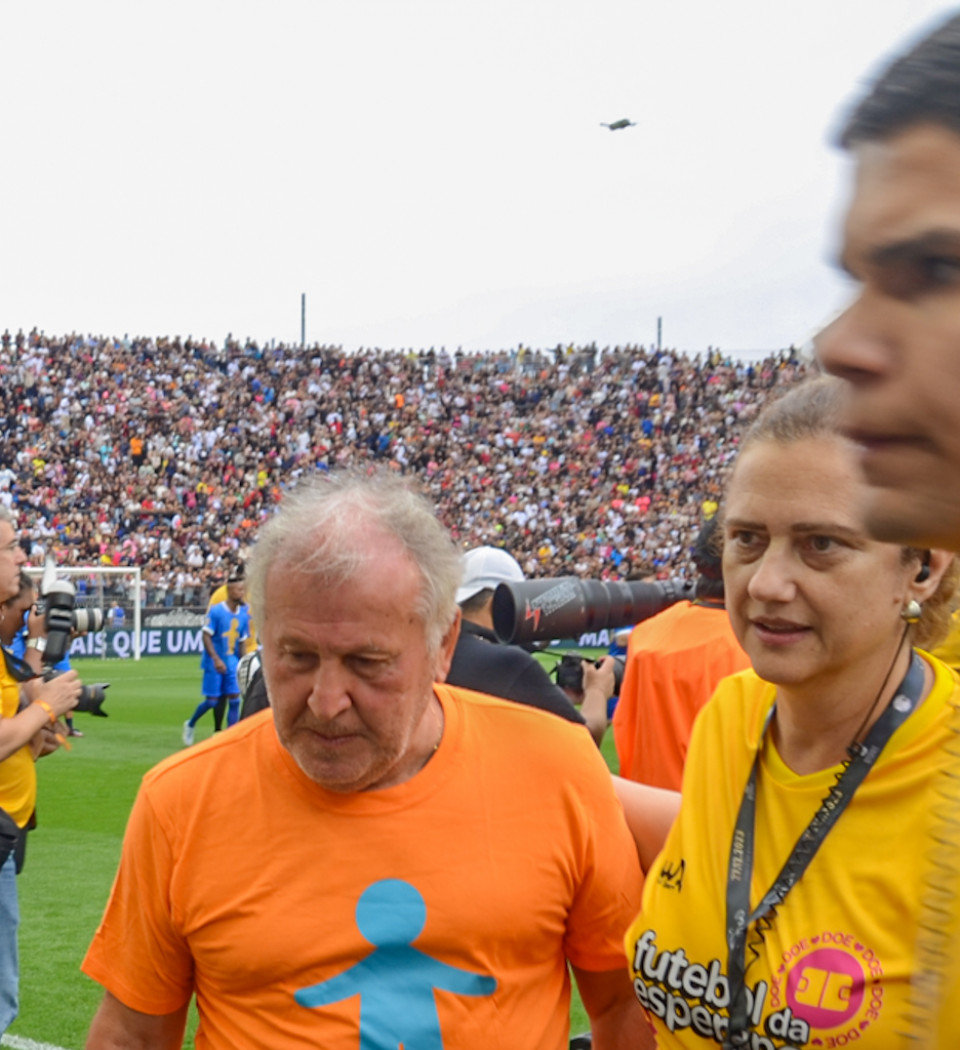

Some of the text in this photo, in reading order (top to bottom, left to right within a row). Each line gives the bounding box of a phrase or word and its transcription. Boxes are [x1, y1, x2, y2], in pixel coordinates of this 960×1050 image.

[70, 631, 107, 654] AIS
[113, 630, 162, 657] QUE
[782, 938, 809, 963] DOE
[822, 931, 855, 947] DOE
[862, 949, 884, 977] DOE
[865, 986, 884, 1020] DOE
[765, 1007, 810, 1044] da
[825, 1028, 861, 1049] DOE
